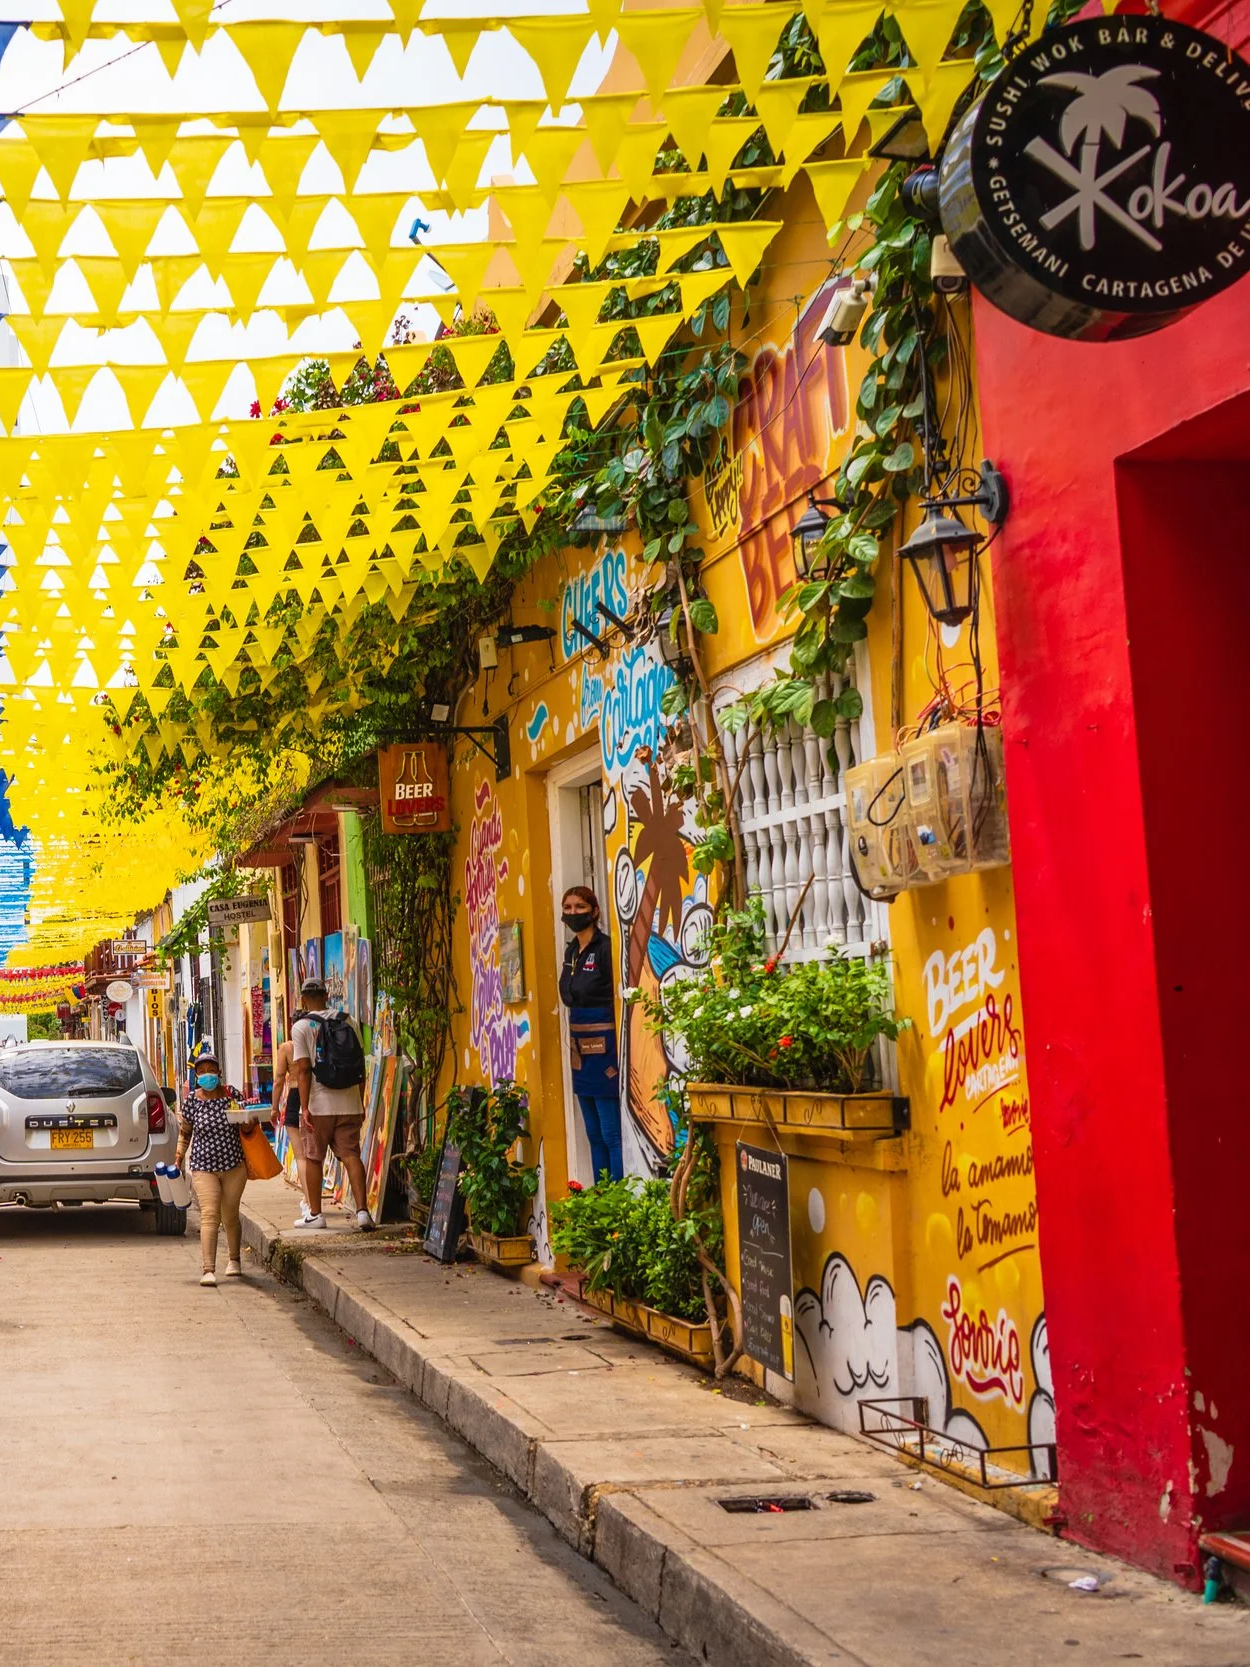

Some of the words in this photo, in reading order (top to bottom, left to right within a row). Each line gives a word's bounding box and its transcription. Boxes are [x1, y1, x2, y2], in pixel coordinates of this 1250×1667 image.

[986, 76, 1029, 147] SUSHI
[1031, 35, 1084, 72] WOK
[1098, 27, 1148, 44] BAR
[1160, 32, 1175, 49] &
[989, 175, 1069, 278] GETSEMANI
[1082, 267, 1213, 298] CARTAGENA
[1217, 241, 1244, 268] DE
[562, 551, 628, 660] CHEERS
[387, 796, 445, 816] LOVERS
[395, 783, 433, 800] BEER
[210, 903, 230, 912] CASA
[232, 899, 268, 909] EUGENIA
[223, 911, 256, 920] HOSTEL
[922, 927, 1005, 1038] BEER
[940, 993, 1021, 1113] lovers
[965, 1046, 1019, 1100] CARTAGENA
[30, 1119, 114, 1128] DUSTER
[52, 1132, 70, 1143] FRY
[73, 1131, 92, 1143] 255
[748, 1155, 782, 1181] PAULANER
[941, 1139, 961, 1197] la
[957, 1206, 973, 1260] la
